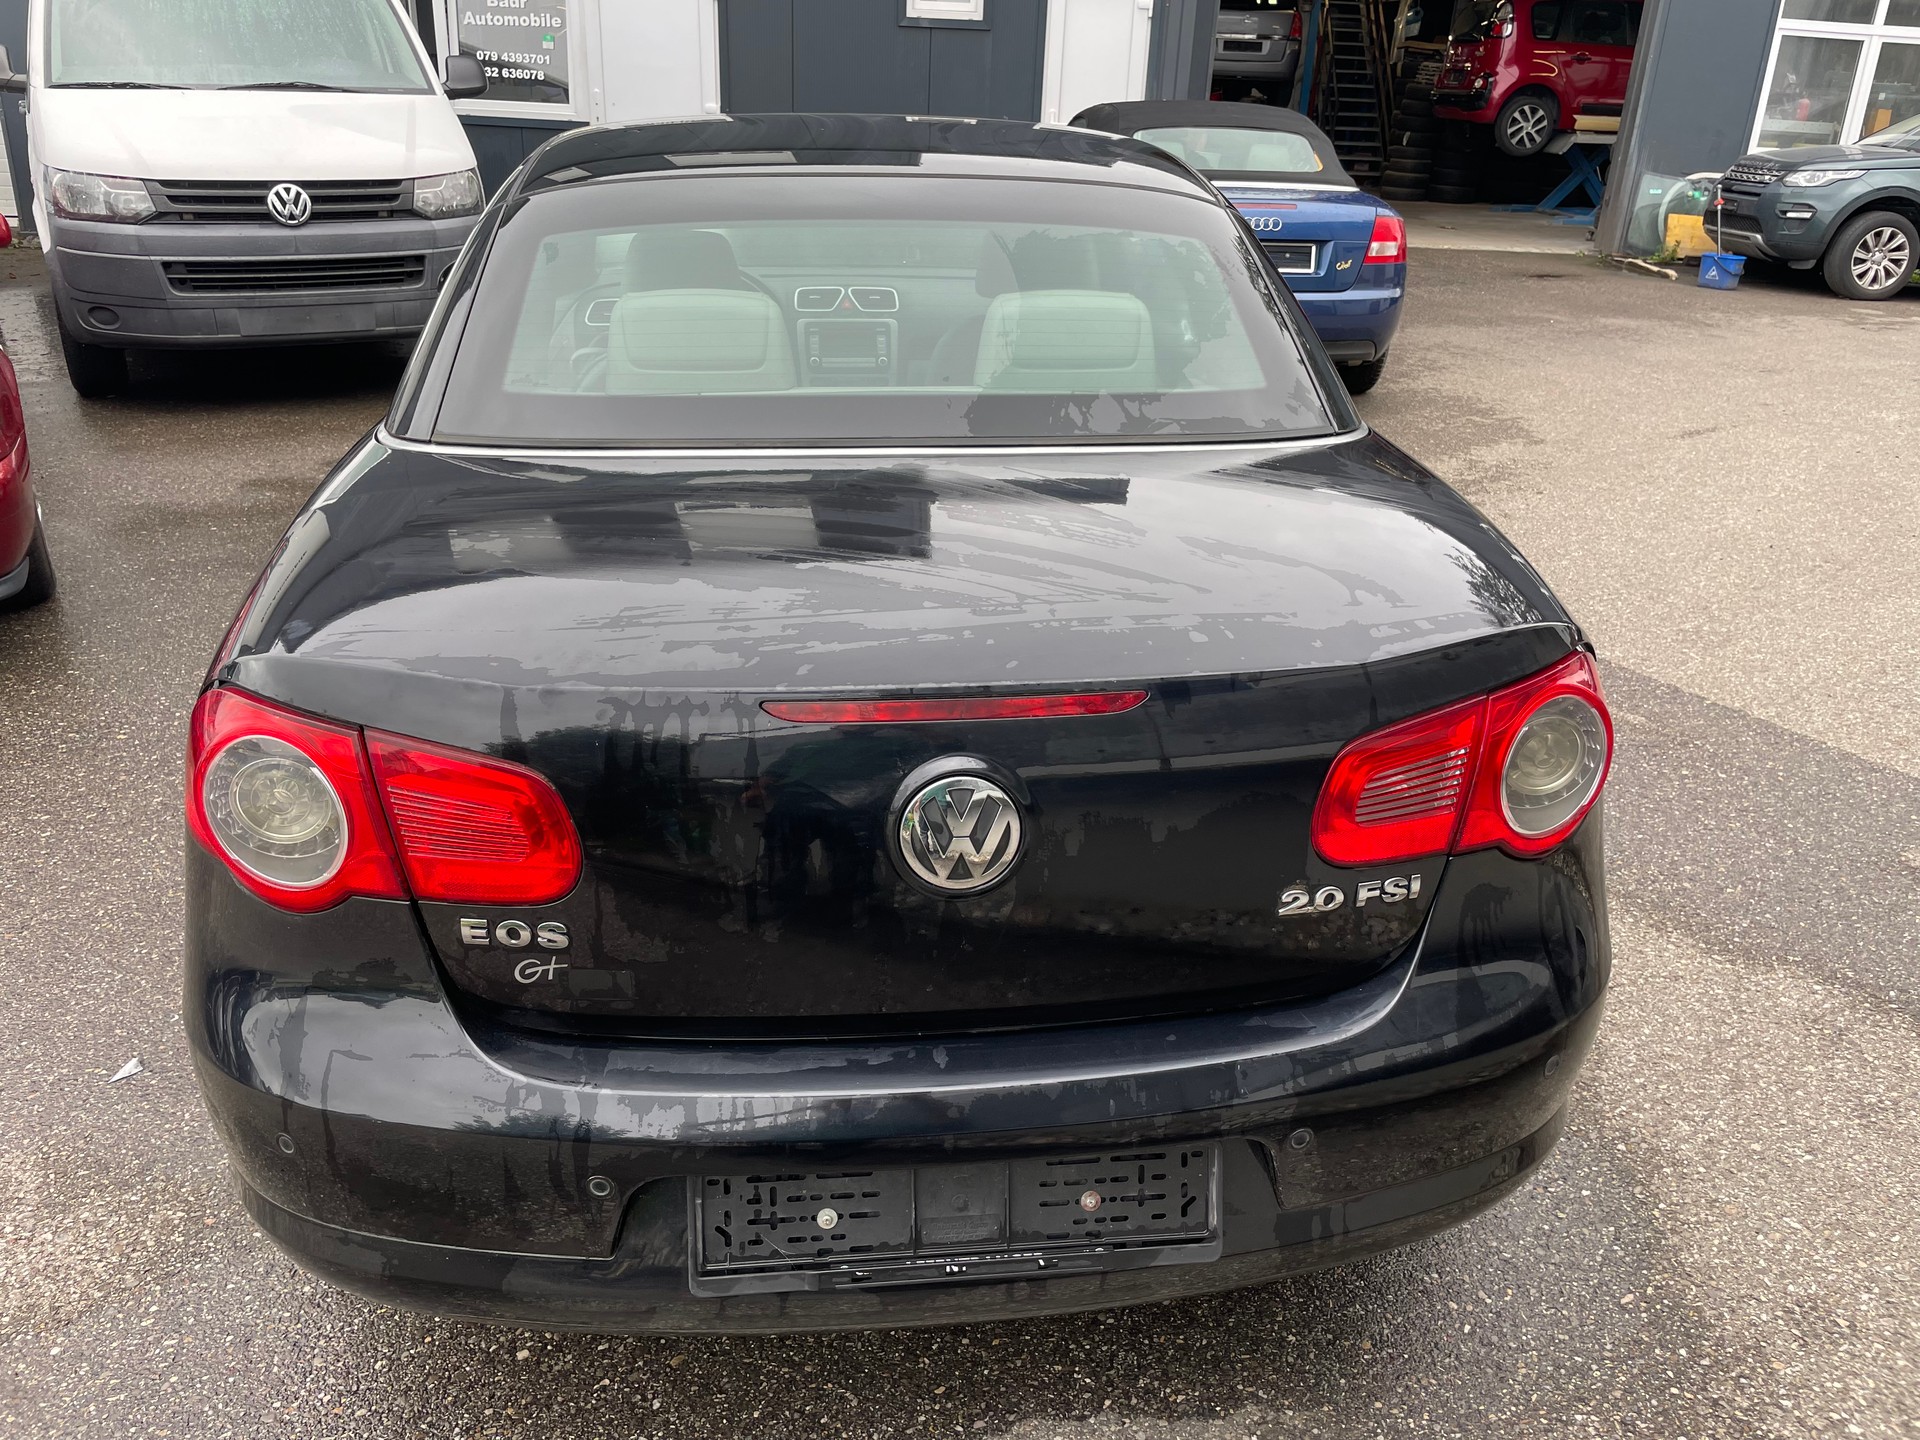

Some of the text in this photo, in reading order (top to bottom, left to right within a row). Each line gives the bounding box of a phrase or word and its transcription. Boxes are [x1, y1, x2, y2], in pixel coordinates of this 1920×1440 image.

[463, 11, 562, 27] Automobile
[476, 50, 550, 65] 079 4393701
[501, 68, 545, 80] 636078
[900, 776, 1020, 889] VW
[1355, 874, 1421, 908] FSI
[460, 918, 569, 949] EOS
